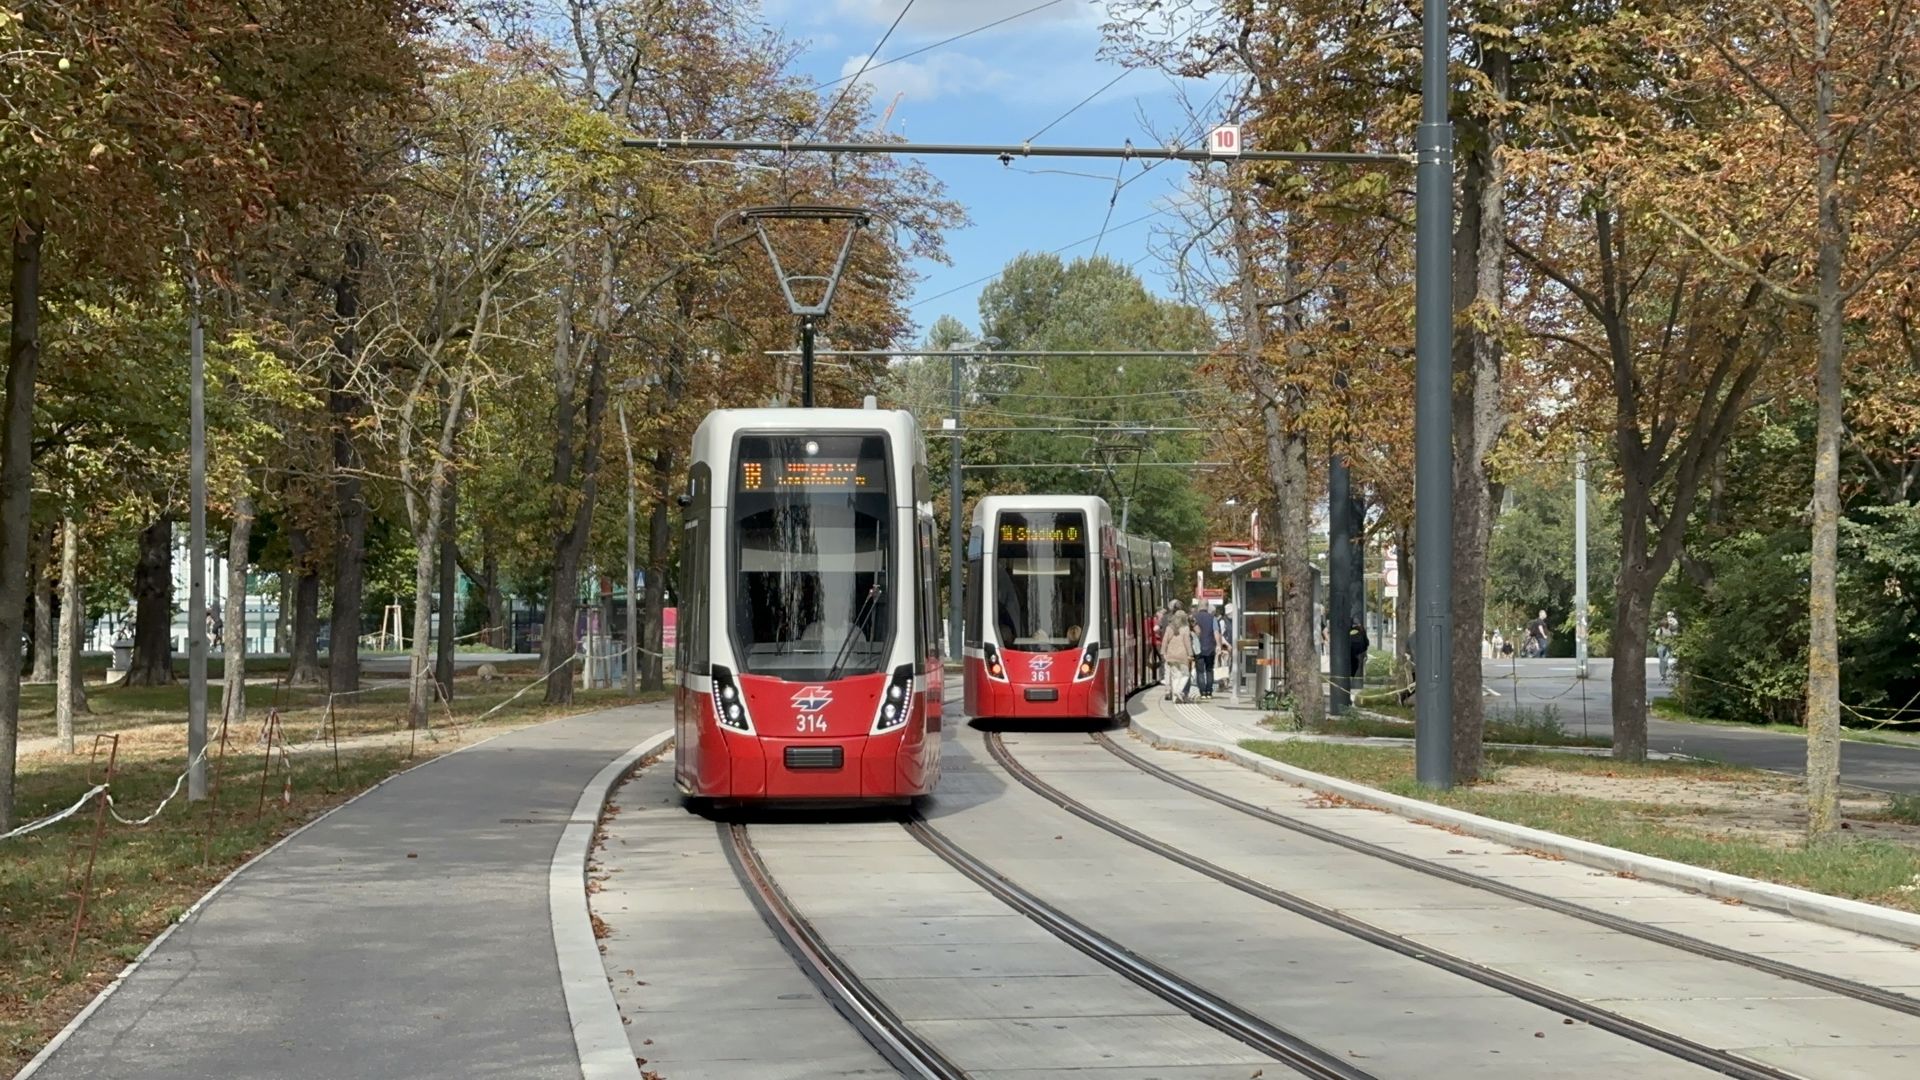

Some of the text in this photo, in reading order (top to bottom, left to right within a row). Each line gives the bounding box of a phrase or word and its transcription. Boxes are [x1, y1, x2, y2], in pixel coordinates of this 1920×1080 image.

[1215, 130, 1234, 148] 10
[1017, 527, 1063, 541] Stadion
[1031, 670, 1051, 682] 361
[796, 714, 827, 732] 314
